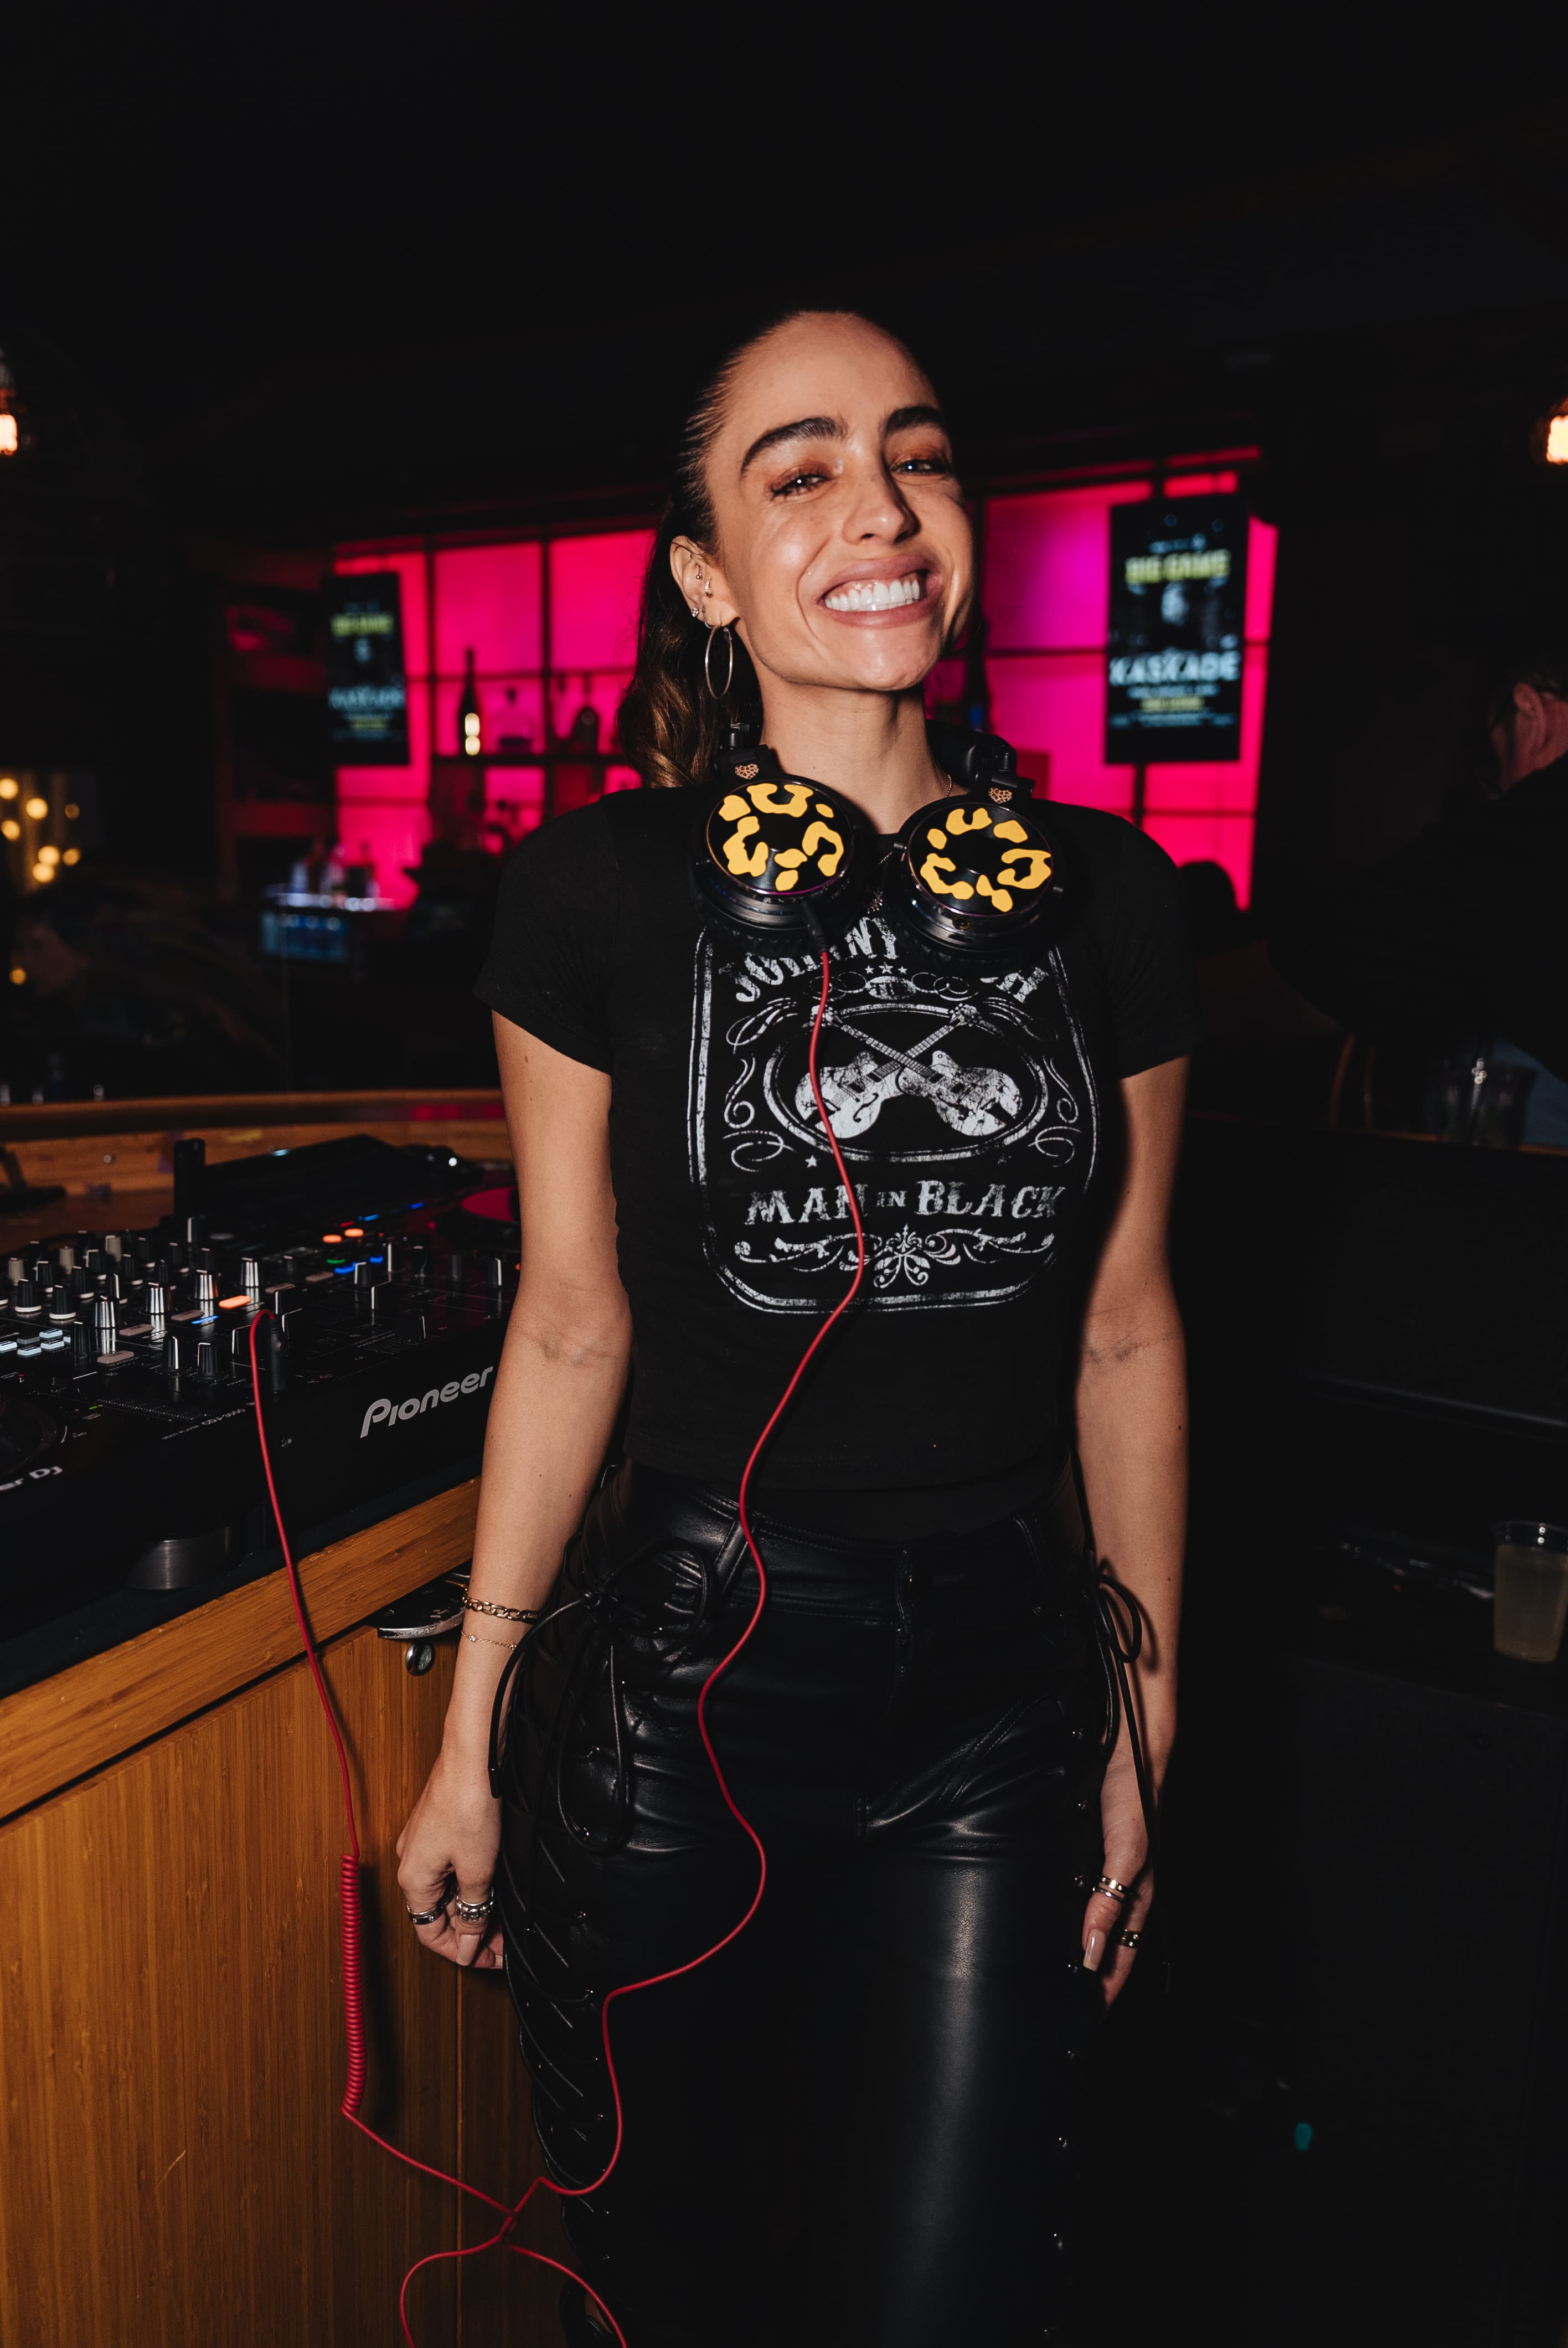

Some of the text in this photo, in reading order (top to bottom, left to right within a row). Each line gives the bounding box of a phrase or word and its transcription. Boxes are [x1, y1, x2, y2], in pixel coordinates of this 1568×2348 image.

[1109, 651, 1241, 686] KASKADE
[744, 1179, 1066, 1226] MAN IN BLACK
[360, 1366, 494, 1439] Pioneer
